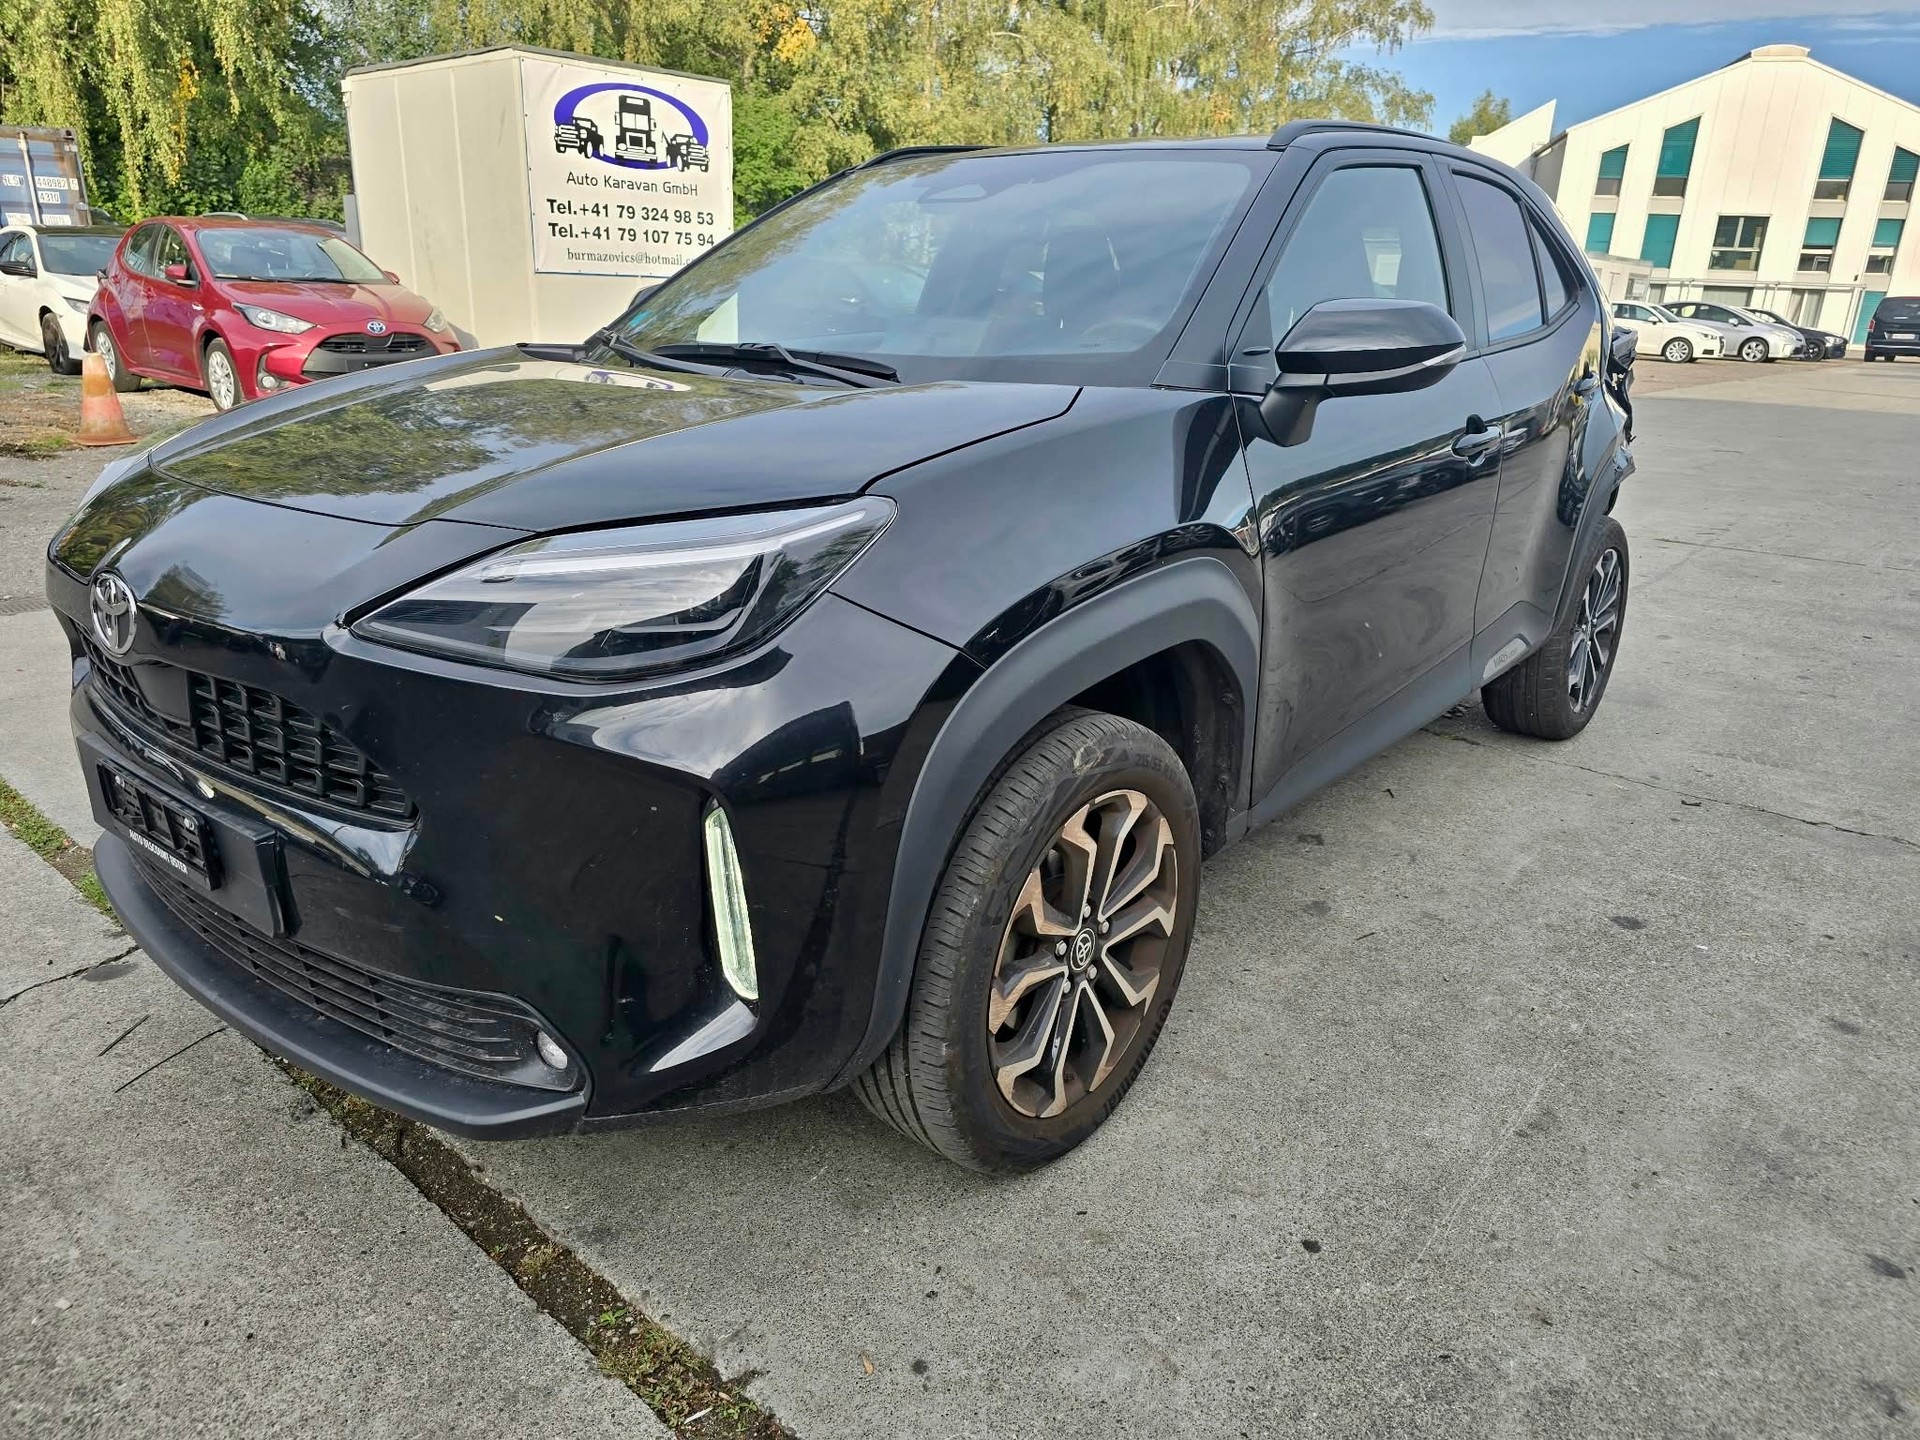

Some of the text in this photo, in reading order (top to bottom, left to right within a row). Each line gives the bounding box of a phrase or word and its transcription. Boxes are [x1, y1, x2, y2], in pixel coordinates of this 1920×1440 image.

[566, 171, 698, 197] Auto Karavan GmbH
[546, 198, 714, 226] Tel.+41 79 324 98 53
[548, 222, 715, 247] Tel.+41 79 107 75 94
